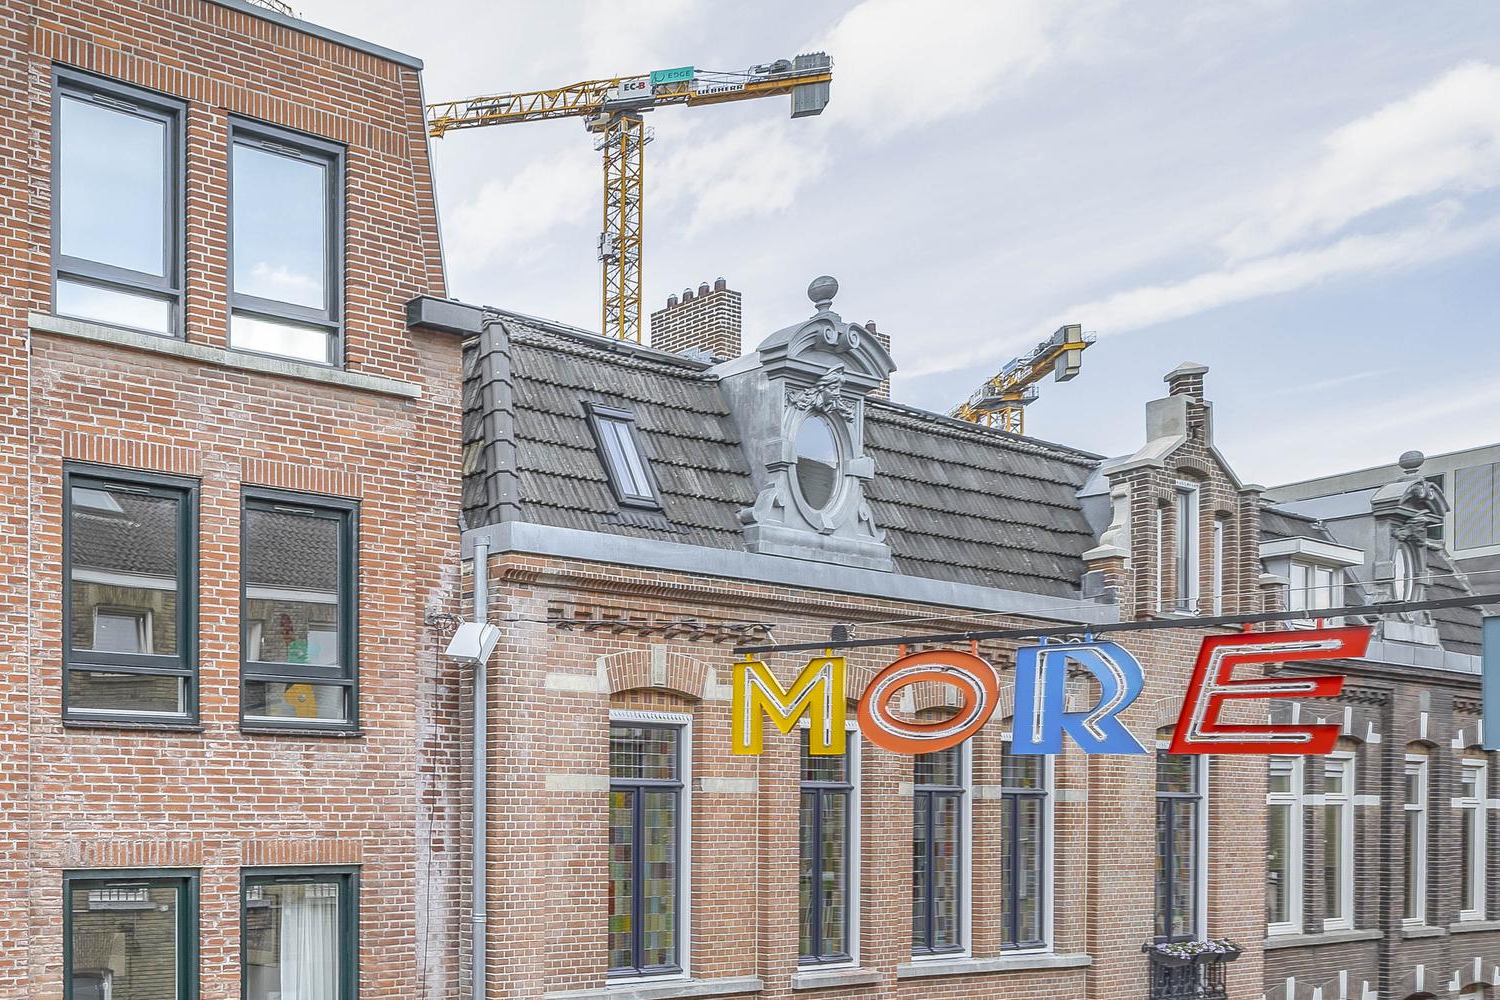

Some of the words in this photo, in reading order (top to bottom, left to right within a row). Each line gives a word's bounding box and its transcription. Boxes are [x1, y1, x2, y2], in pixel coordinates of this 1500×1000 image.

[668, 70, 691, 79] EDGE
[623, 81, 646, 92] EC-B
[732, 625, 1374, 755] MORE
